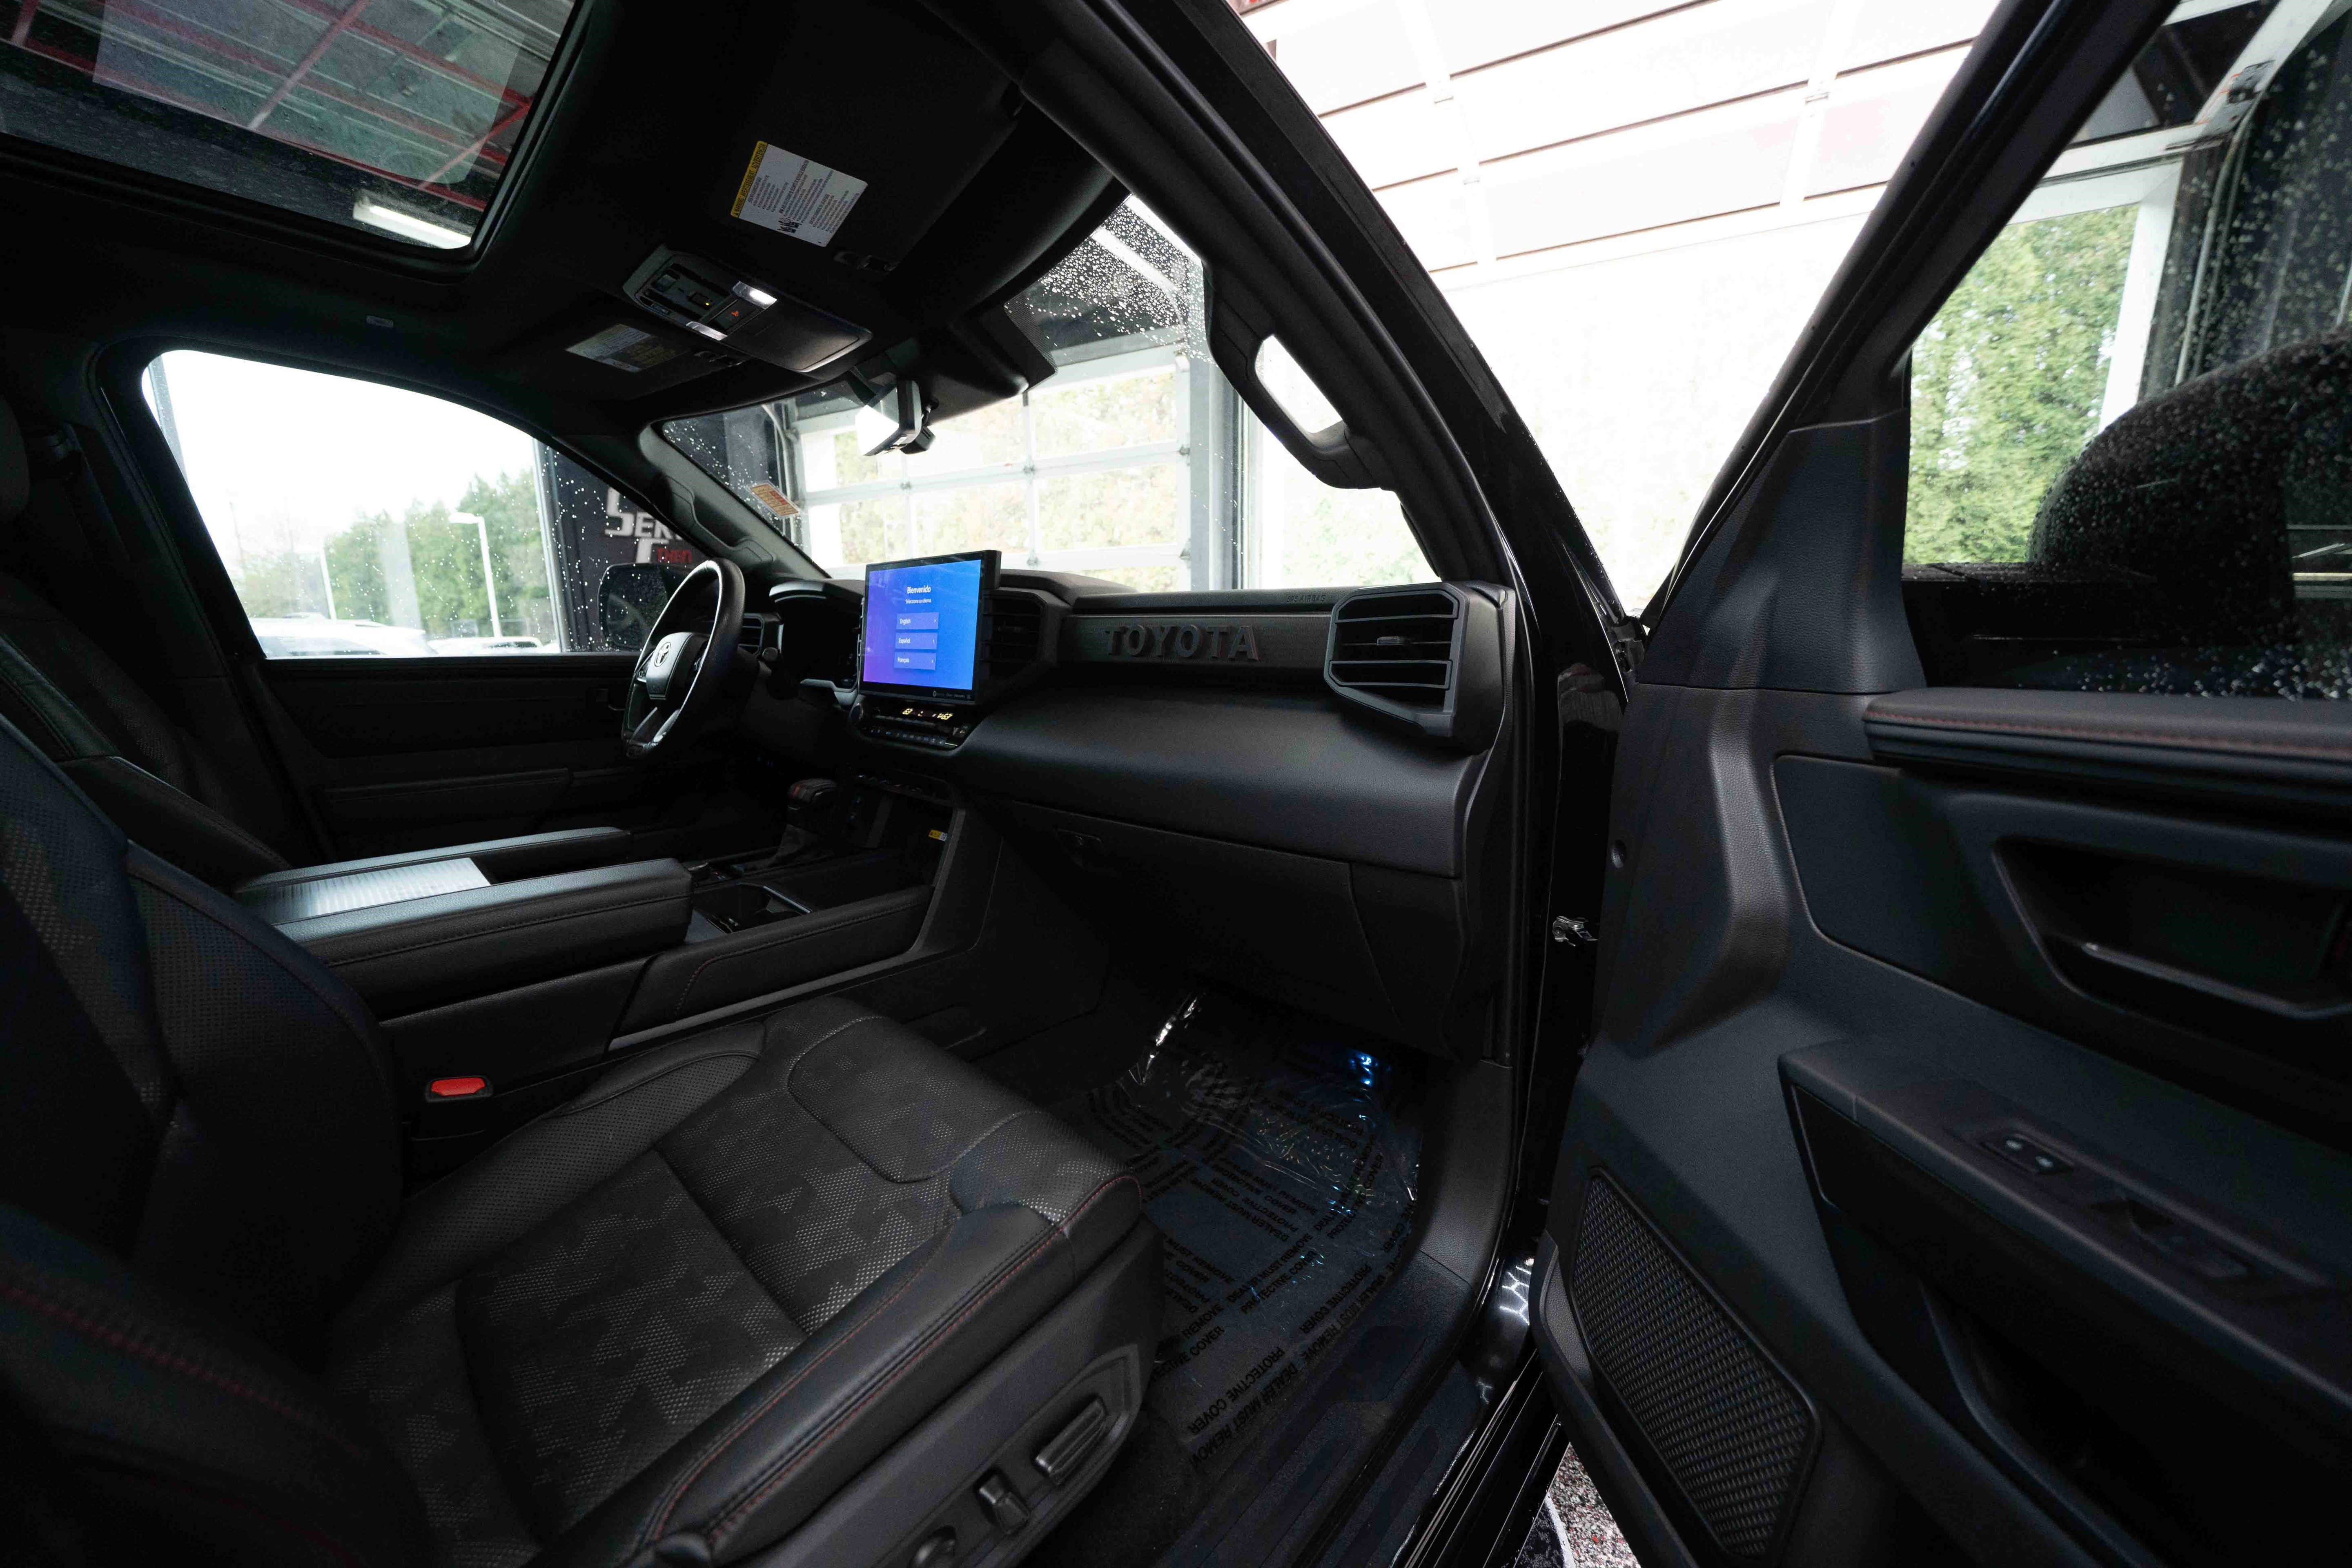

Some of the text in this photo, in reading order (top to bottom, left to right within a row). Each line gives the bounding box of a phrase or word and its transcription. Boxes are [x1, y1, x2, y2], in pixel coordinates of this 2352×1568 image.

[907, 585, 931, 594] Bienvenido
[1300, 594, 1327, 603] AIRBAG
[1105, 624, 1260, 662] TOYOTA
[1363, 1154, 1383, 1189] COVER
[1225, 1199, 1251, 1218] MUST
[1242, 1197, 1298, 1232] PROTECTIVE
[1265, 1194, 1296, 1214] COVER
[1279, 1190, 1317, 1214] REMOVE
[1251, 1215, 1289, 1242] DEALER
[1382, 1222, 1404, 1253] COVER
[1193, 1255, 1234, 1284] REMOVE
[1227, 1233, 1312, 1303] DEALER MUST REMOVE
[1240, 1249, 1316, 1313] PROTECTIVE COVER
[1300, 1264, 1371, 1334] PROTECTIVE COVER
[1182, 1303, 1225, 1338] REMOVE
[1189, 1325, 1224, 1356] COVER
[1300, 1324, 1339, 1361] REMOVE
[1188, 1346, 1285, 1435] PROTECTIVE COVER
[1187, 1363, 1299, 1468] DEALER MUST REMOV
